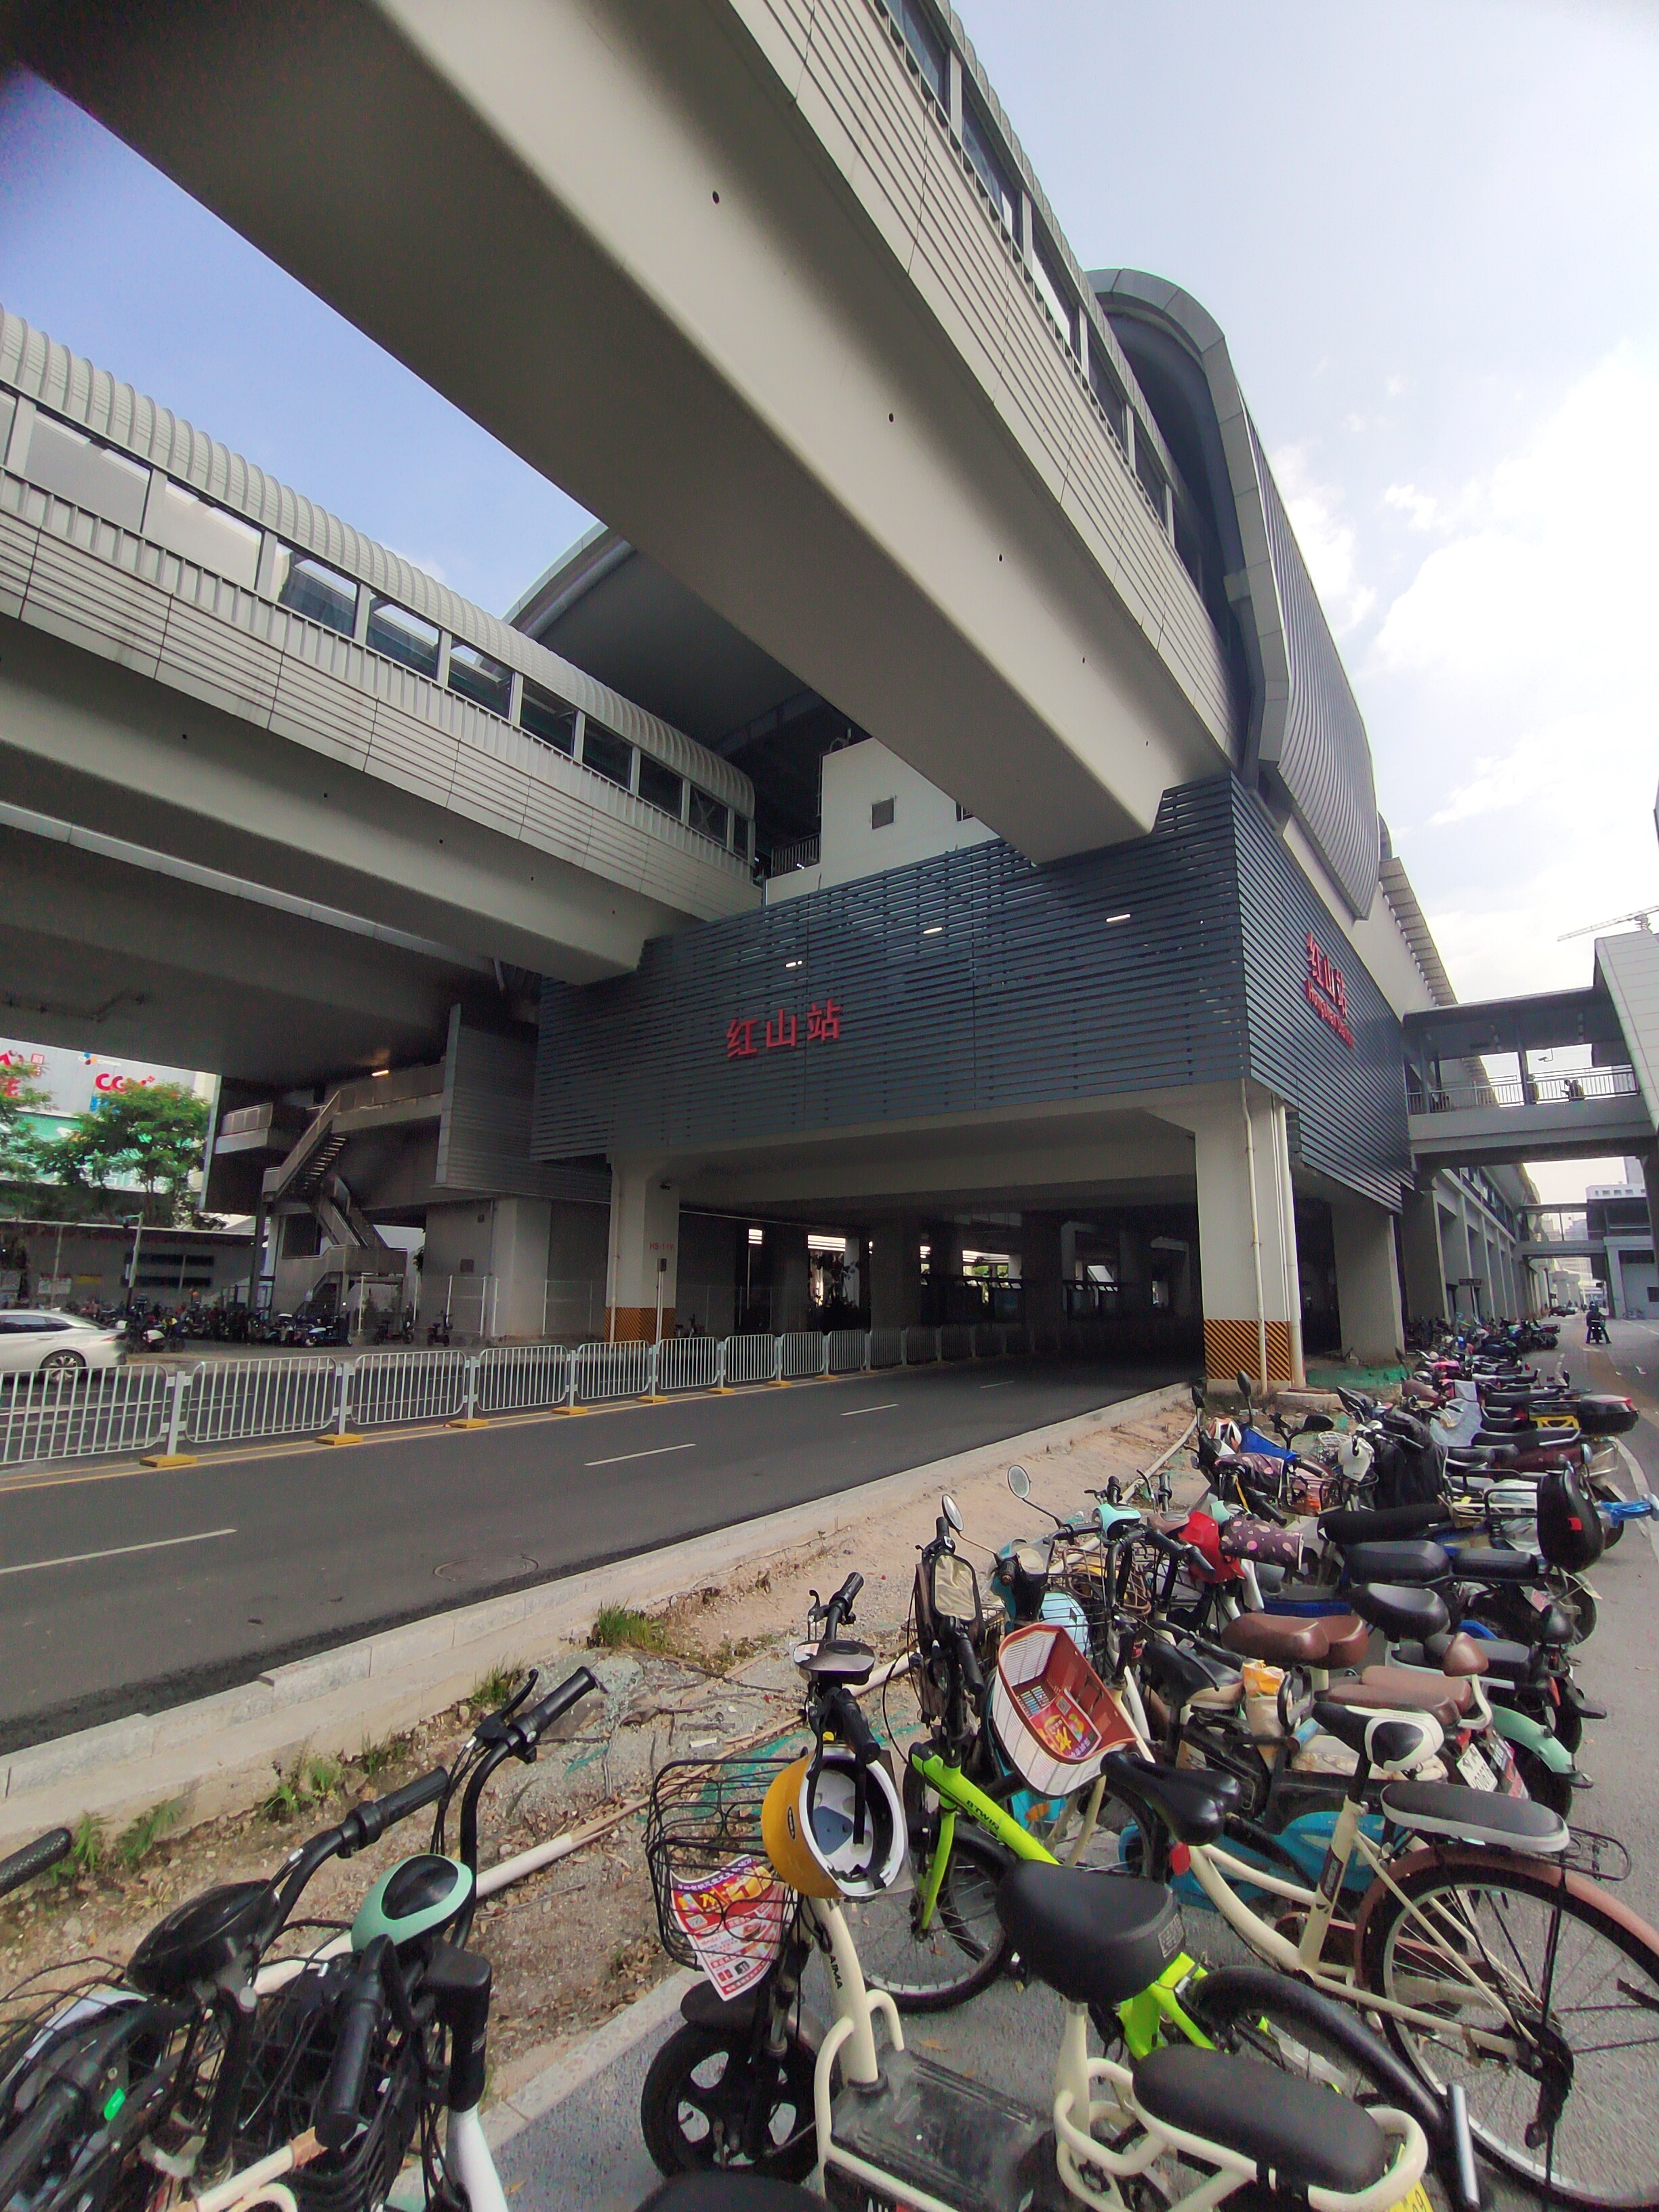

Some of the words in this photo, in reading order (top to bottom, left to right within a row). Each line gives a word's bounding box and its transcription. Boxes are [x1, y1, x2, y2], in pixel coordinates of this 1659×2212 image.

[726, 998, 842, 1058] 红山站
[830, 1954, 843, 1989] AIMA
